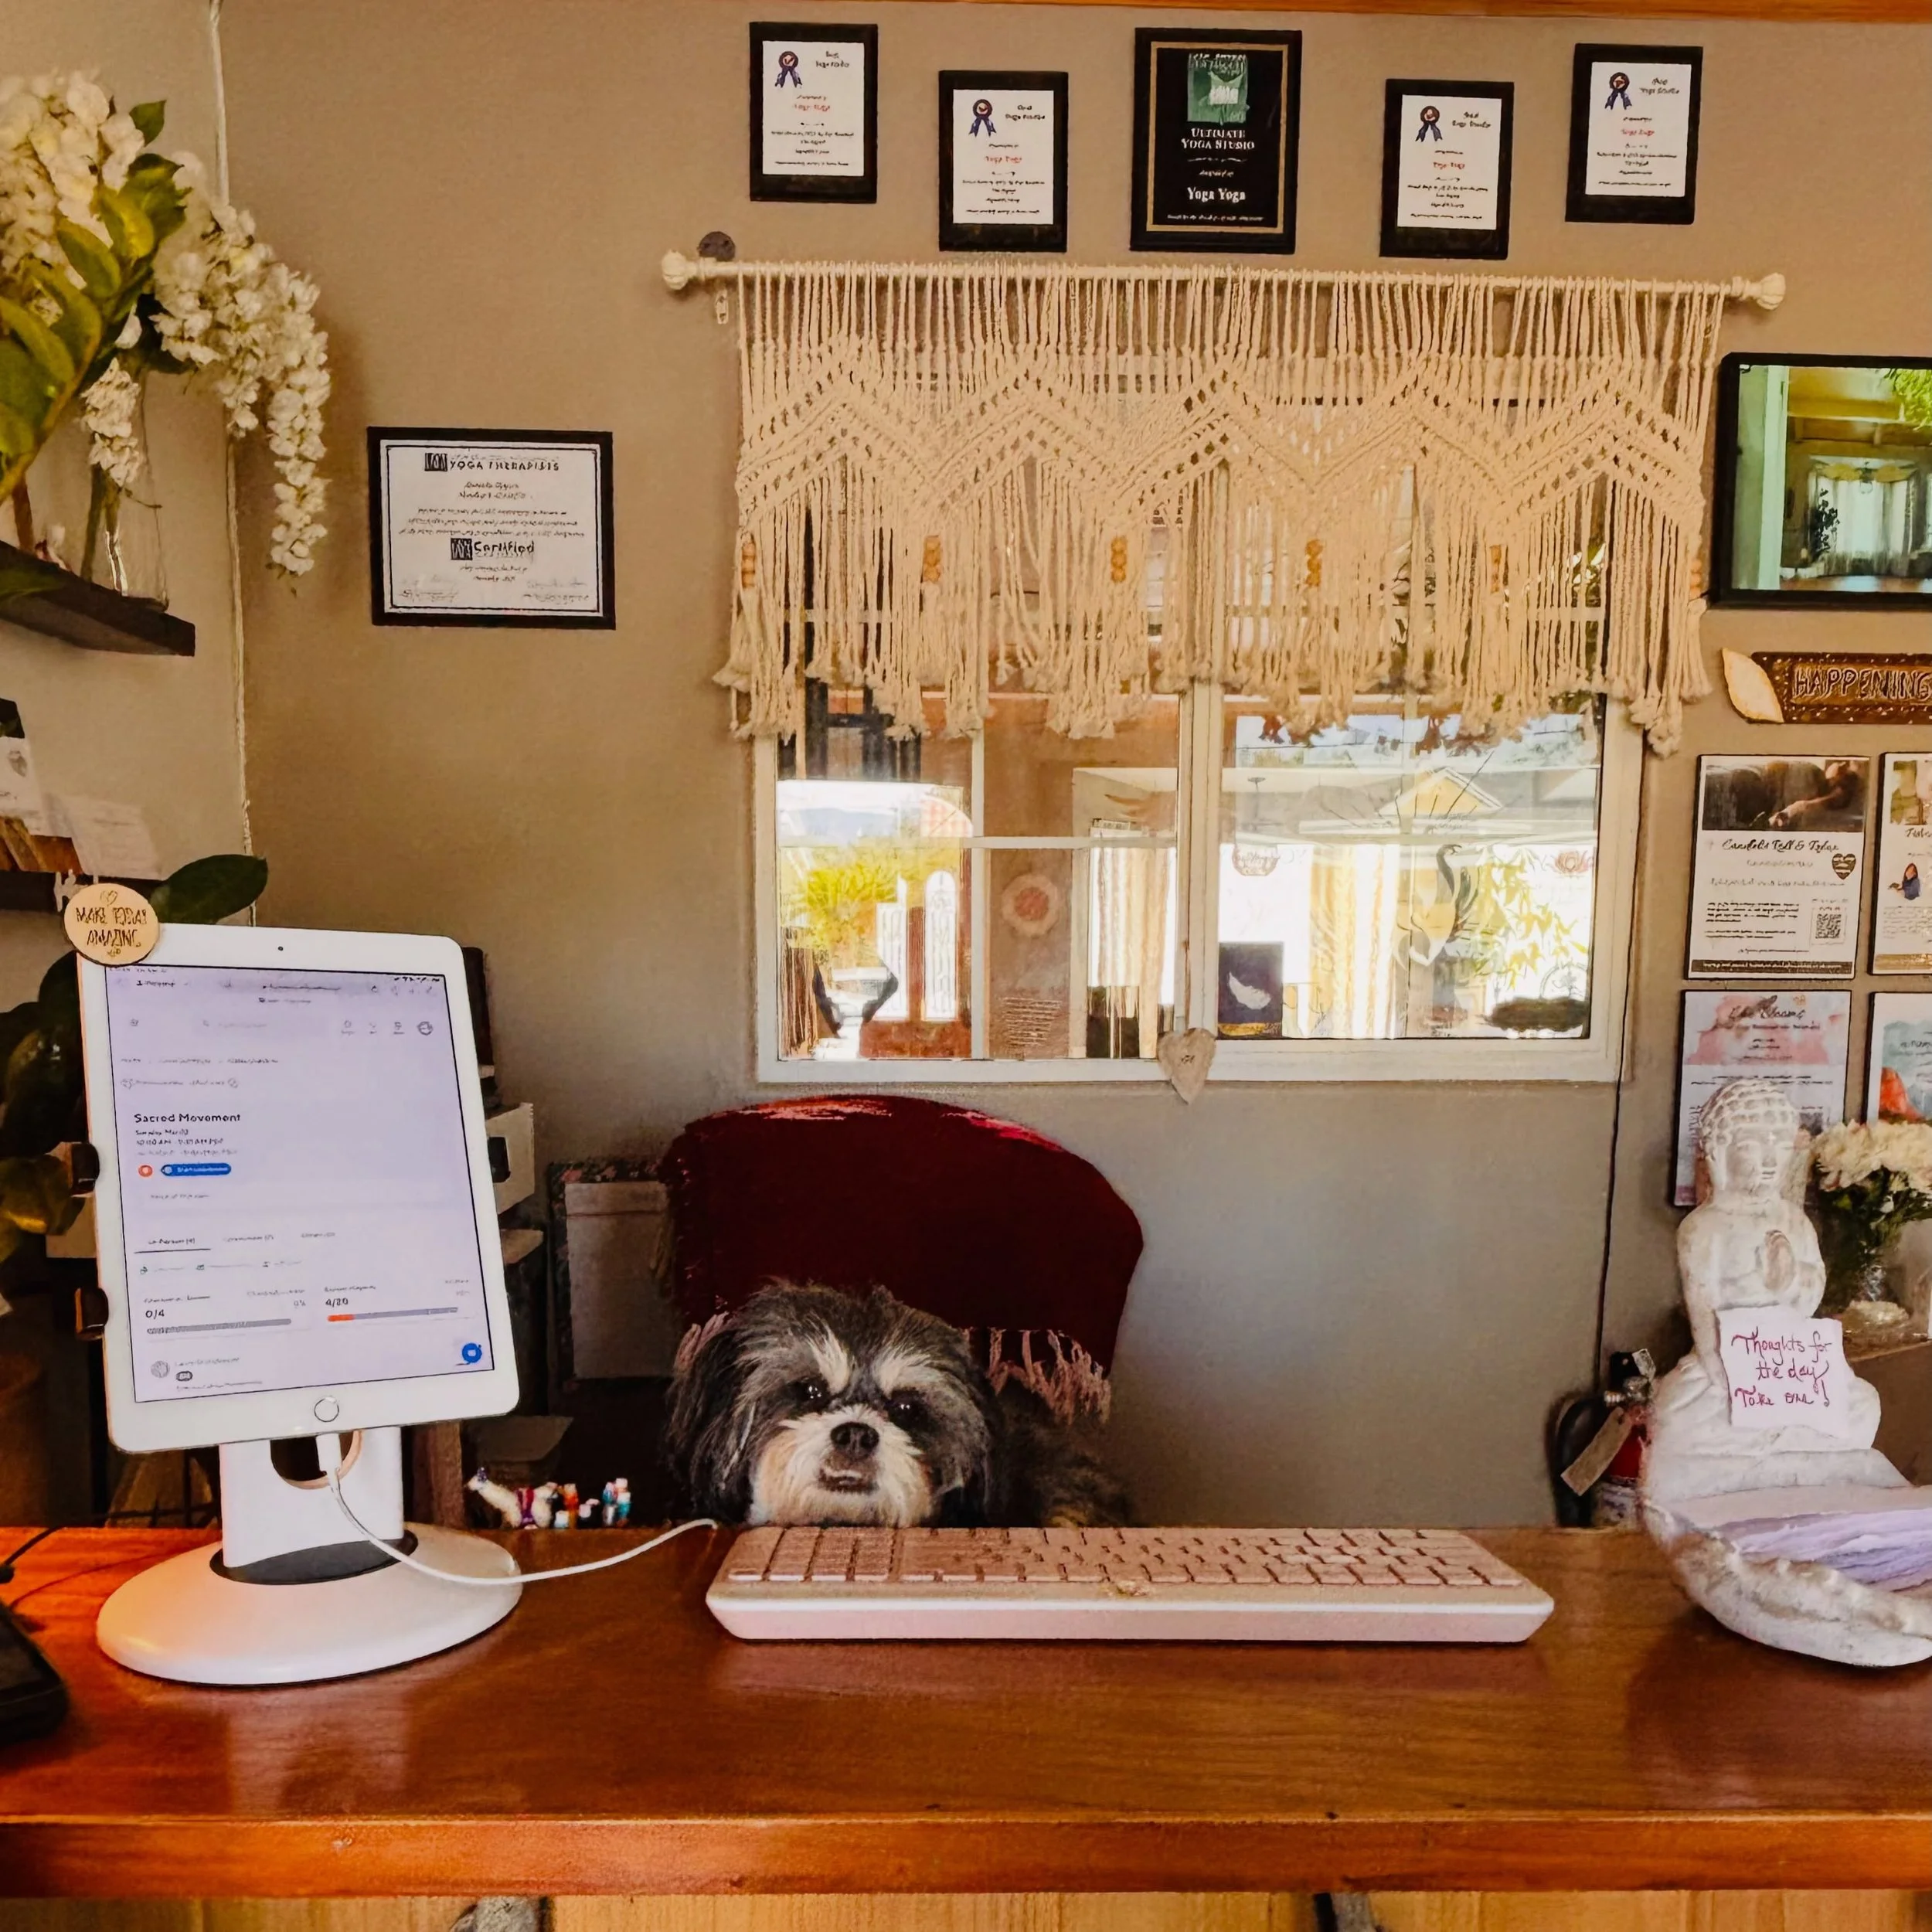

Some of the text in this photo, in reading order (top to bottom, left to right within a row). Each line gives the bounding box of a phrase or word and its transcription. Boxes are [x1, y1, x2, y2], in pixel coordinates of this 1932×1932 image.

[1181, 138, 1212, 149] YOGA
[1187, 186, 1246, 203] Yoga Yoga
[450, 461, 483, 471] YOGA
[134, 1114, 240, 1123] Sacred Movement
[145, 1309, 165, 1319] 0/4
[1808, 1331, 1832, 1362] for
